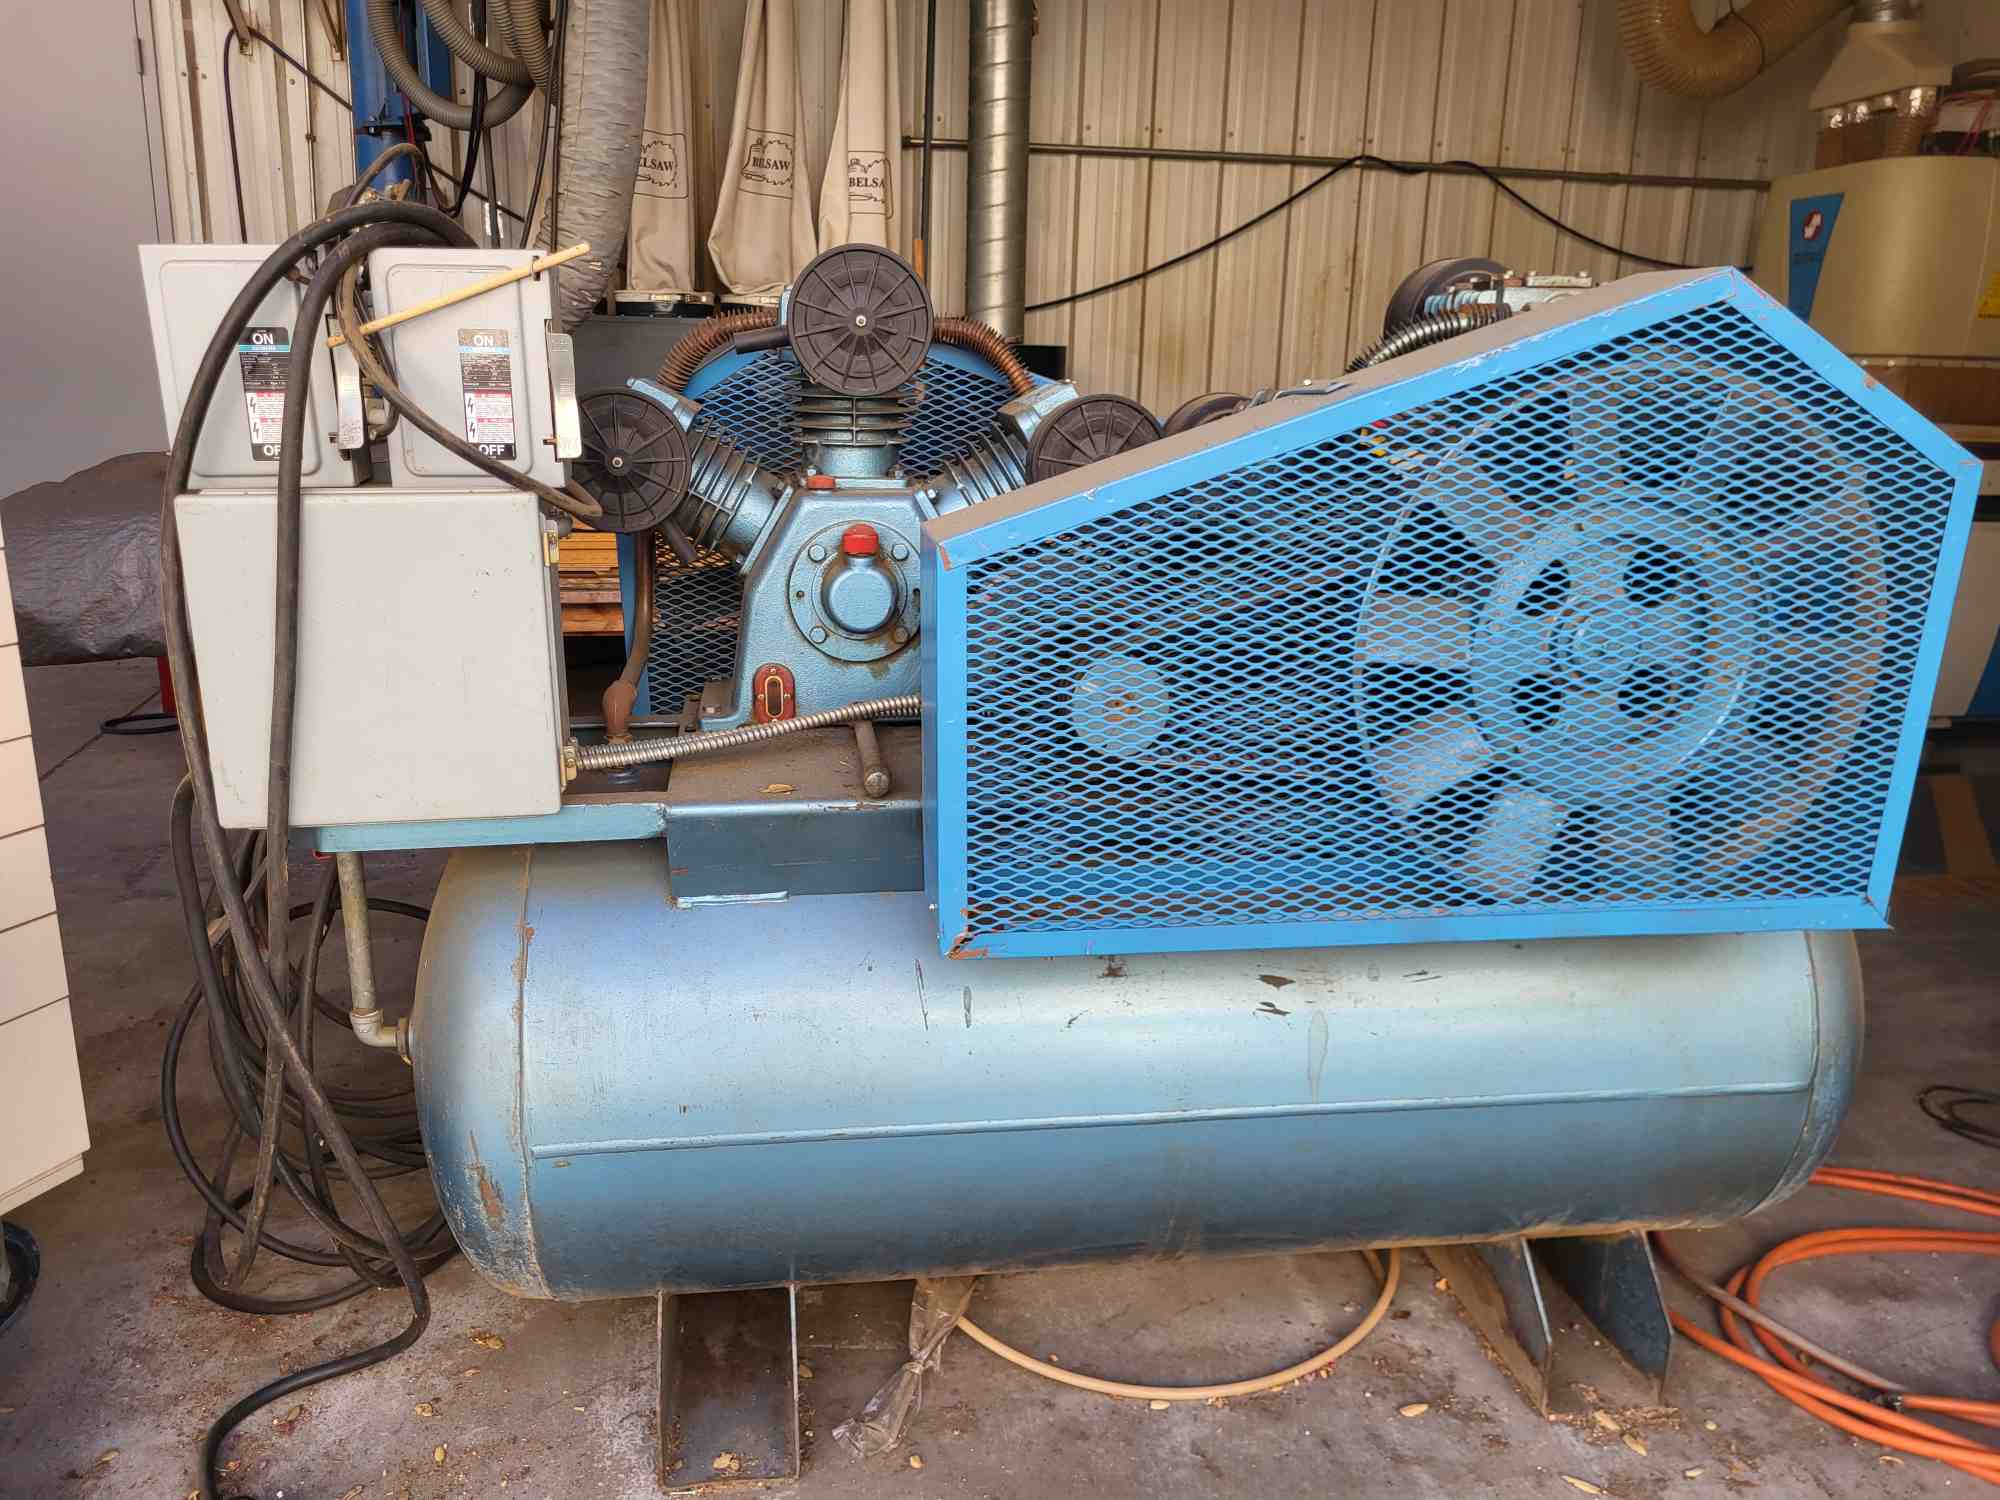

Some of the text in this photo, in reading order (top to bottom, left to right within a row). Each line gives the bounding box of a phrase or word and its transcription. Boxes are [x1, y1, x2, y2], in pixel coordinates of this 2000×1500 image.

[848, 177, 886, 189] BELSA
[252, 333, 274, 345] ON
[473, 335, 494, 346] ON
[263, 444, 281, 457] OF
[479, 444, 505, 456] OFF
